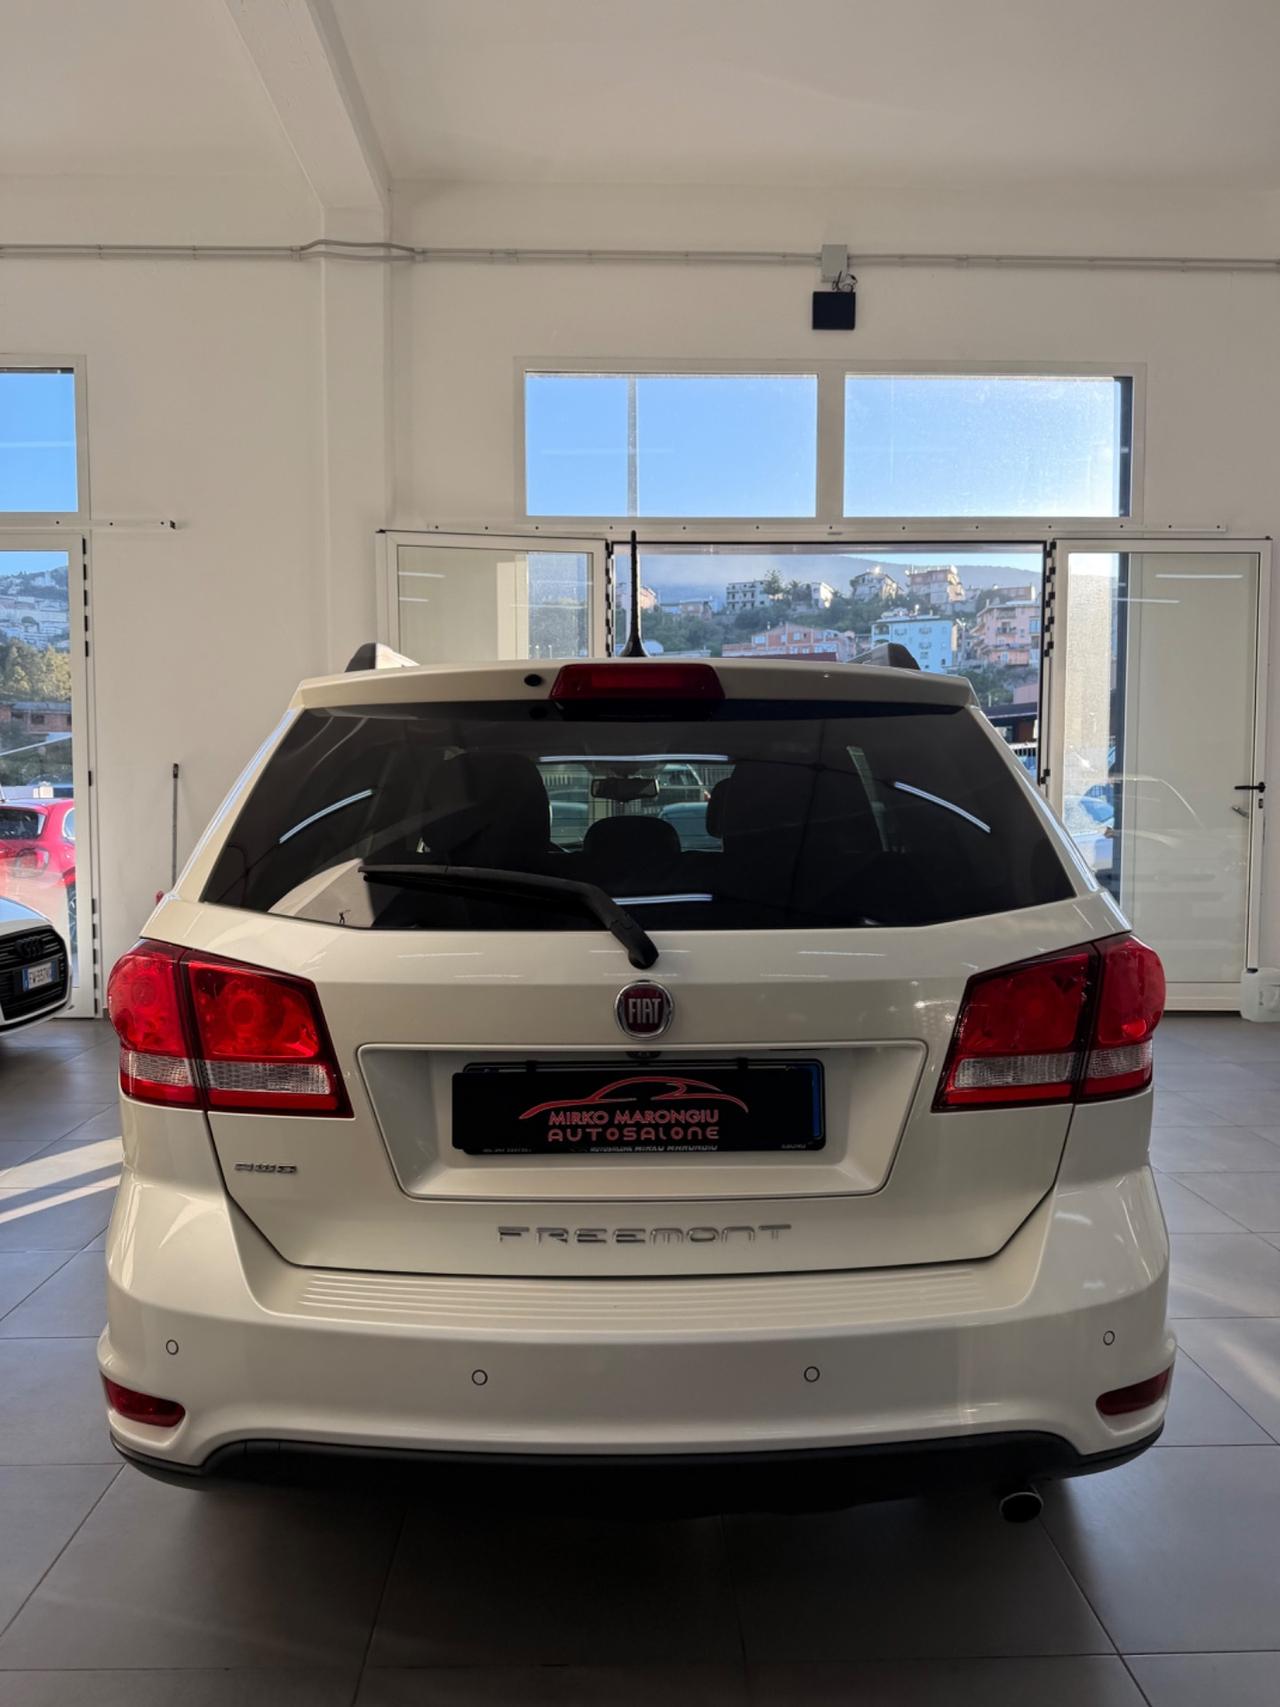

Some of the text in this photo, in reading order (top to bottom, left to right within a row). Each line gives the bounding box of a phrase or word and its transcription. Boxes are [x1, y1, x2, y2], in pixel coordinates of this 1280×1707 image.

[628, 998, 661, 1024] FIAT
[549, 1109, 719, 1125] MIRKO MARONGIU
[548, 1126, 719, 1142] AUTOSALONE
[497, 1224, 792, 1245] FREEMONT
